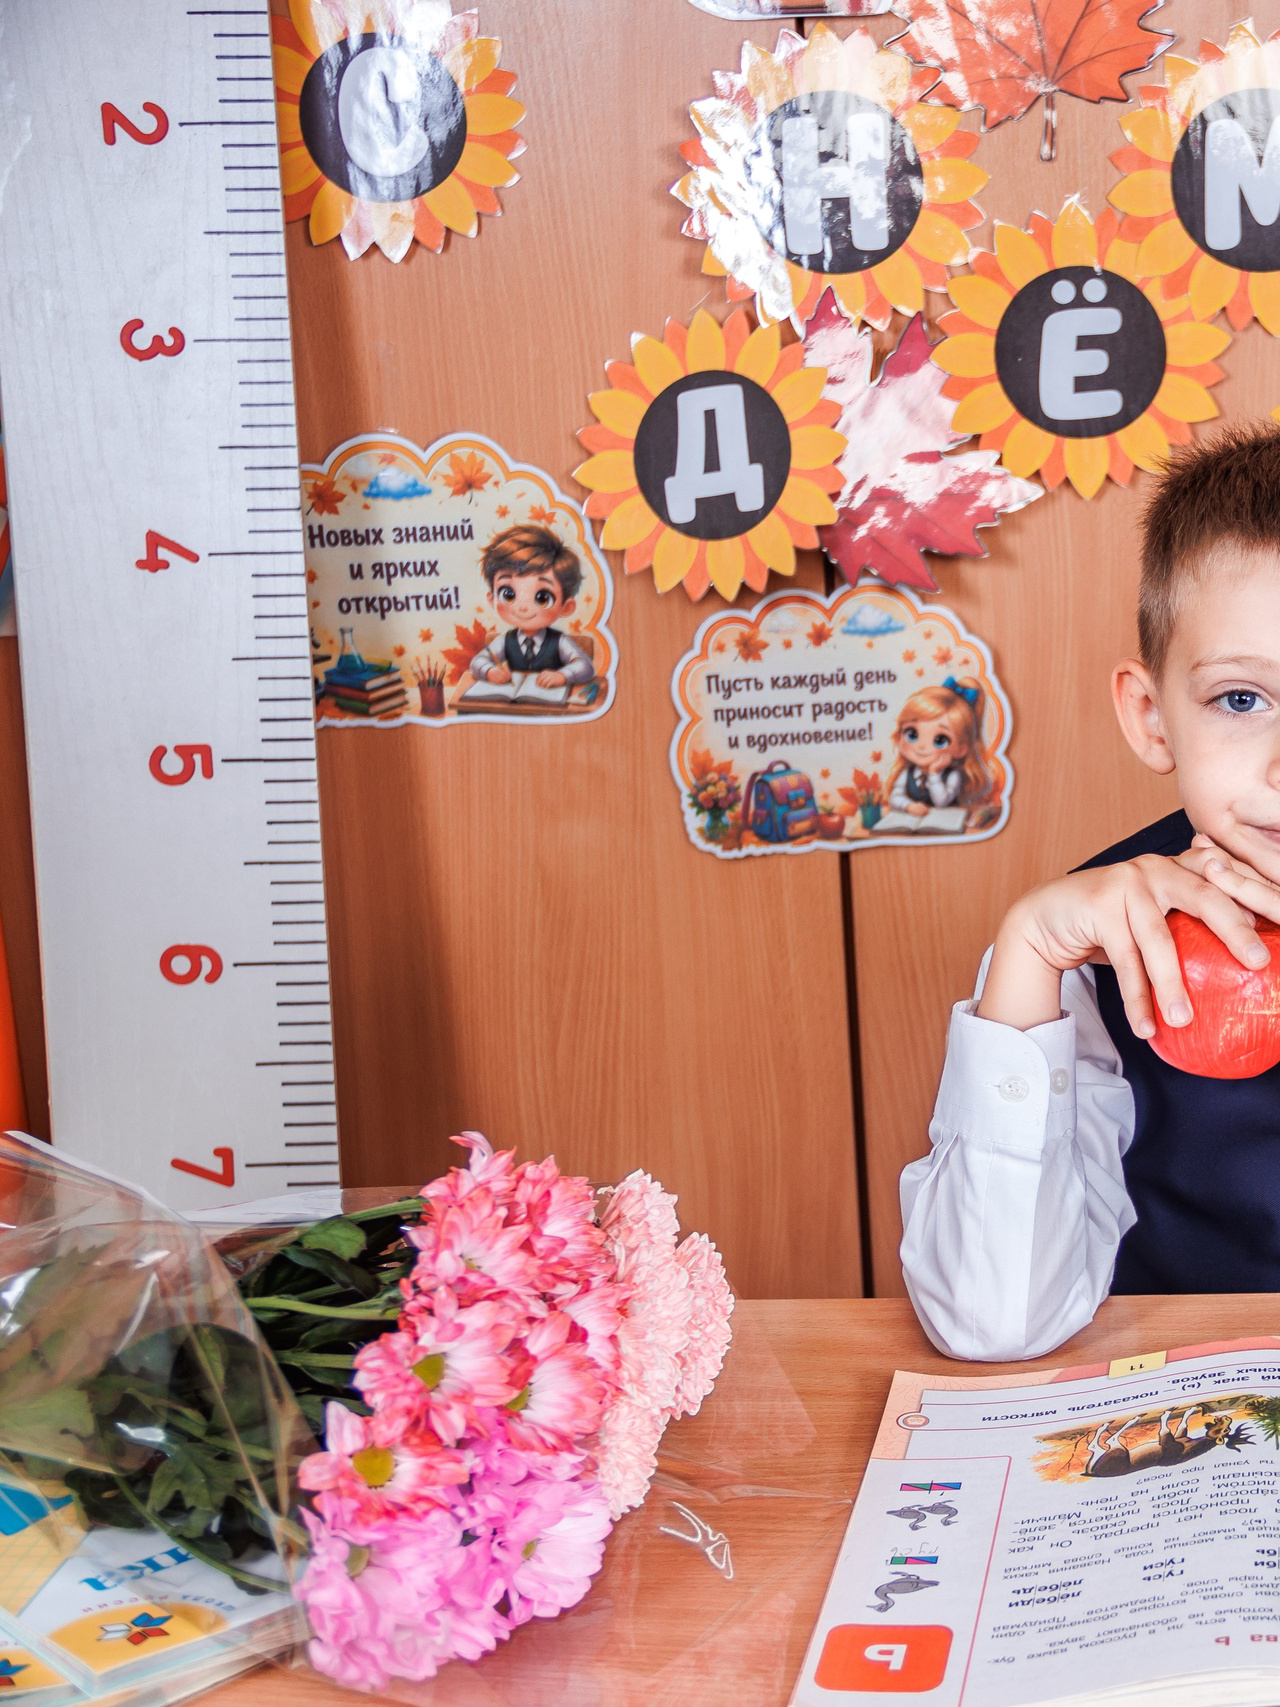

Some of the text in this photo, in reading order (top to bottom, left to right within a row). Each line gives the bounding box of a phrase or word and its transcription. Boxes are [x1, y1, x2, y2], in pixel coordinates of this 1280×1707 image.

[338, 46, 430, 178] С
[102, 101, 169, 146] 2
[782, 112, 890, 256] Н
[120, 318, 185, 361] 3
[1039, 279, 1123, 420] Ё
[664, 384, 765, 524] Д
[307, 518, 474, 548] Новых знаний
[136, 529, 200, 573] 4
[349, 559, 440, 586] и ярких
[338, 587, 461, 619] открытий!
[705, 667, 897, 700] Пусть каждый день
[714, 697, 887, 727] приносит радость
[729, 722, 873, 753] и вдохновение!
[149, 743, 214, 786] 5
[160, 943, 224, 986] 6
[170, 1146, 235, 1188] 7
[1166, 1371, 1226, 1384] звуков.
[1212, 1376, 1250, 1386] знак
[1067, 1390, 1159, 1412] показатель
[981, 1409, 1057, 1422] мягкости
[1181, 1465, 1205, 1475] про
[1213, 1459, 1250, 1469] узнал
[1136, 1472, 1173, 1485] лося?
[1161, 1478, 1200, 1491] соли
[1130, 1488, 1149, 1497] на
[1148, 1486, 1200, 1502] любит
[1076, 1495, 1119, 1506] пень.
[1095, 1499, 1137, 1512] соль.
[1151, 1497, 1192, 1510] Лось
[1219, 1507, 1258, 1516] лося
[1175, 1513, 1203, 1524] нет
[1012, 1523, 1057, 1535] зелё-
[1071, 1520, 1127, 1535] сквозь
[1089, 1521, 1160, 1542] преград.
[1191, 1527, 1236, 1538] имеют
[1010, 1534, 1046, 1544] лес-
[1049, 1540, 1072, 1549] Он
[1163, 1537, 1215, 1551] месяцы
[1007, 1545, 1034, 1555] как
[1113, 1542, 1153, 1555] конце
[1121, 1548, 1154, 1558] года.
[1063, 1552, 1102, 1565] слова
[1004, 1561, 1052, 1574] мягкий
[1048, 1557, 1111, 1574] Названия
[1002, 1571, 1039, 1581] каких
[1182, 1578, 1218, 1587] слов.
[1228, 1575, 1264, 1583] пары
[1180, 1585, 1224, 1596] много
[1198, 1591, 1243, 1601] слова,
[1082, 1594, 1165, 1616] предметов.
[1129, 1598, 1187, 1614] которые
[992, 1616, 1066, 1633] Придумай
[1035, 1612, 1118, 1634] обозначают
[1045, 1606, 1273, 1648] которые обозначают звука.
[1195, 1617, 1226, 1626] есть
[991, 1630, 1025, 1640] один
[1078, 1631, 1137, 1650] русском
[1026, 1647, 1068, 1660] языке
